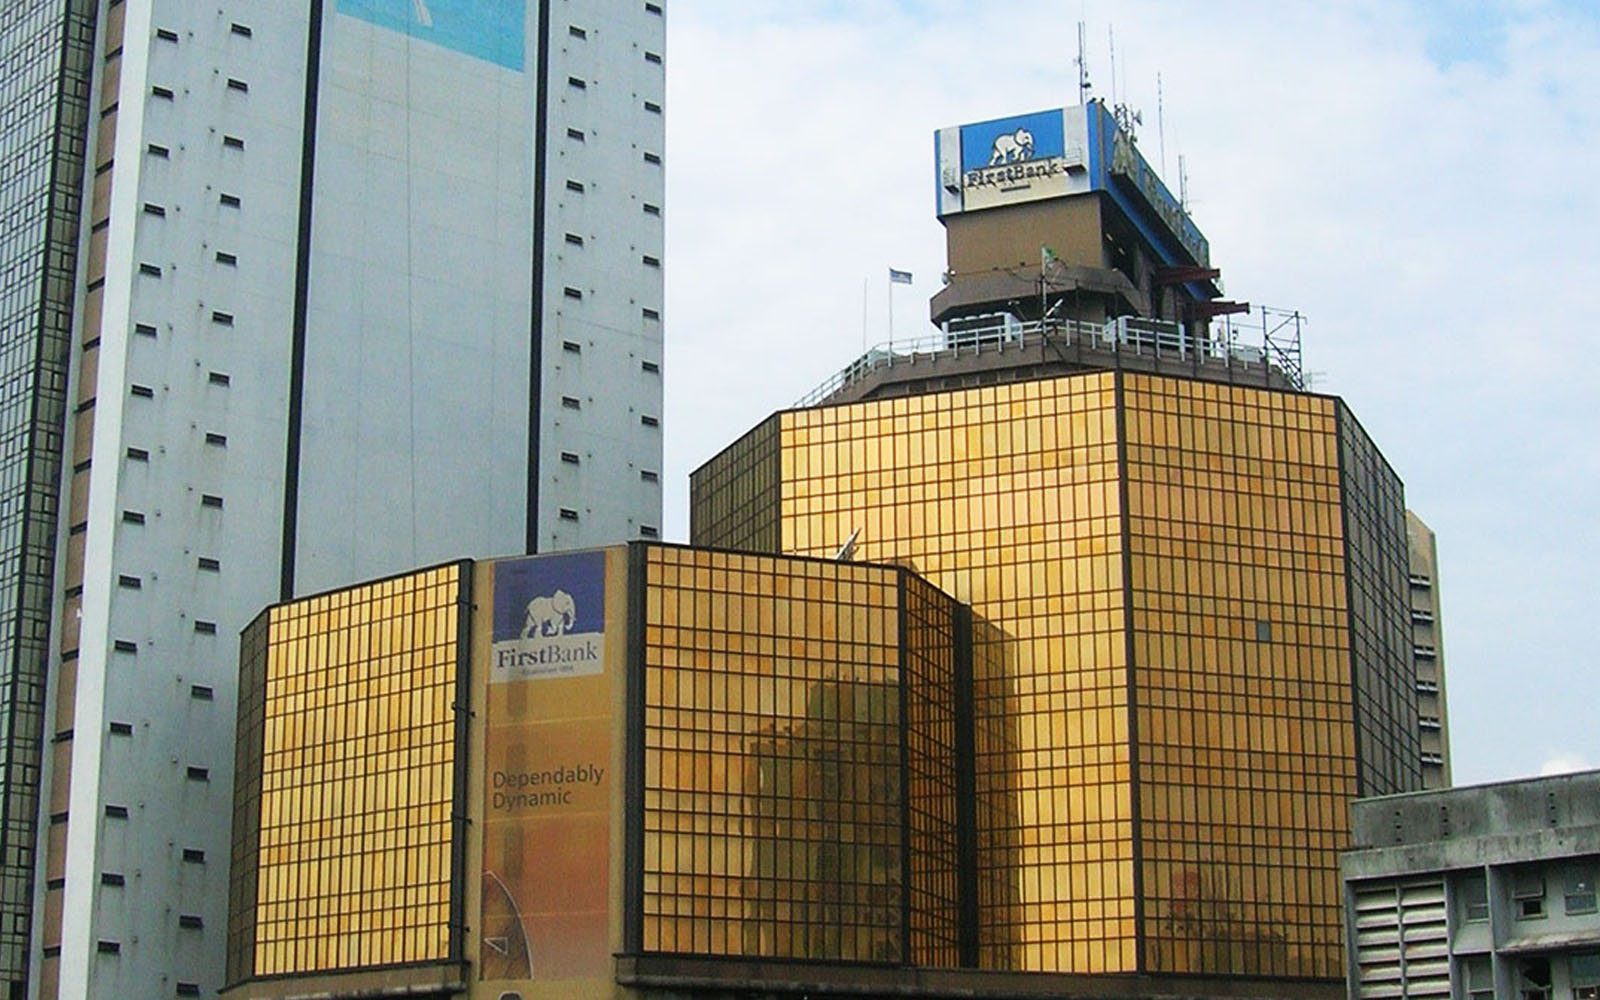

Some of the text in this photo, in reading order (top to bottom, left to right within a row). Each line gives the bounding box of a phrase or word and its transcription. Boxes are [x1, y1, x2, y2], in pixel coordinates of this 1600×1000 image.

[966, 160, 1058, 187] FirstBank
[498, 642, 598, 667] FirstBank
[493, 764, 604, 790] Dependably
[493, 787, 572, 811] Dynamic
